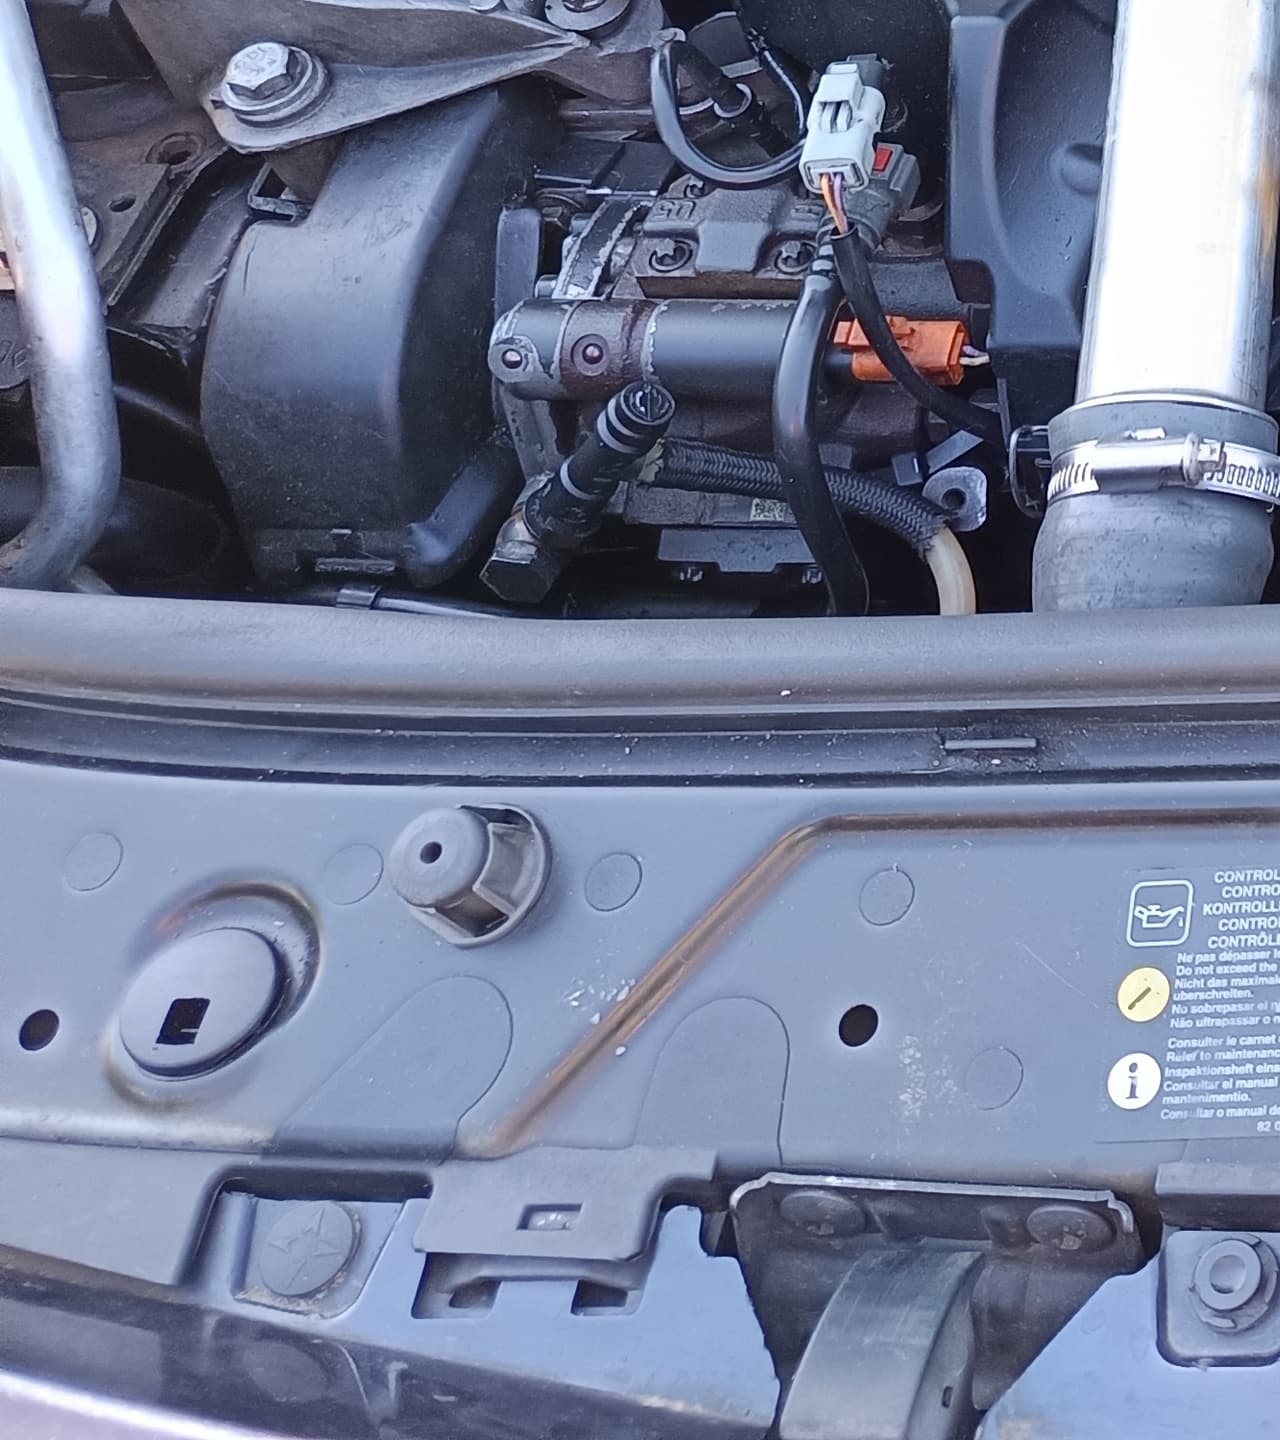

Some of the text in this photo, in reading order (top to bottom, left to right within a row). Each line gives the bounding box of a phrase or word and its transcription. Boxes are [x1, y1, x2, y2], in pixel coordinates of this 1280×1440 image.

[1176, 965, 1193, 976] Do
[1195, 964, 1214, 975] not
[1216, 961, 1257, 975] exceed
[1259, 961, 1278, 972] the
[1174, 977, 1205, 990] Nicht
[1206, 976, 1228, 988] das
[1171, 1003, 1188, 1015] No
[1189, 1000, 1256, 1015] sobrepasar
[1235, 1076, 1278, 1089] manual
[1216, 1108, 1224, 1119] o
[1225, 1105, 1268, 1118] manual
[1256, 1121, 1273, 1133] 82
